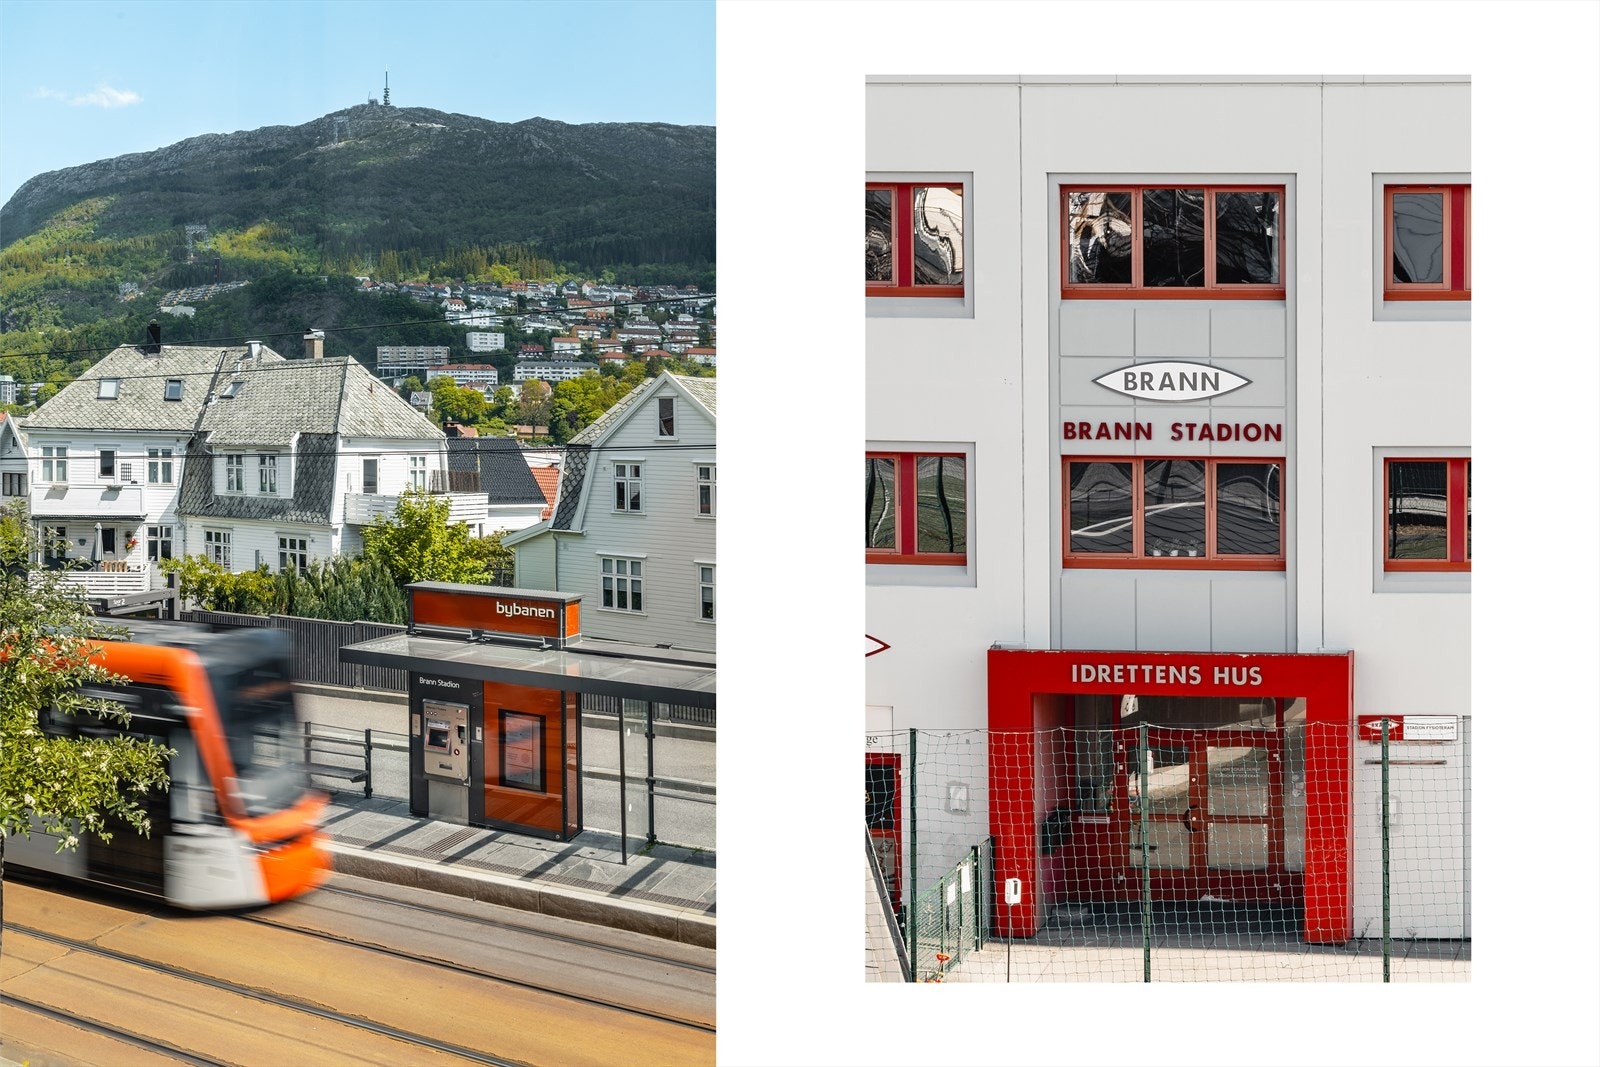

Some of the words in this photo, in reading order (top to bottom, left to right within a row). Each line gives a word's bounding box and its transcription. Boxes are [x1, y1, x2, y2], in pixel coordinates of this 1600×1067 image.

[1123, 371, 1220, 392] BRANN
[1063, 421, 1153, 441] BRANN
[1170, 422, 1282, 442] STADION
[496, 601, 555, 618] bybanen
[419, 676, 437, 686] Brann
[437, 679, 460, 689] Stadion
[1072, 664, 1202, 685] IDRETTENS
[1213, 666, 1263, 686] HUS
